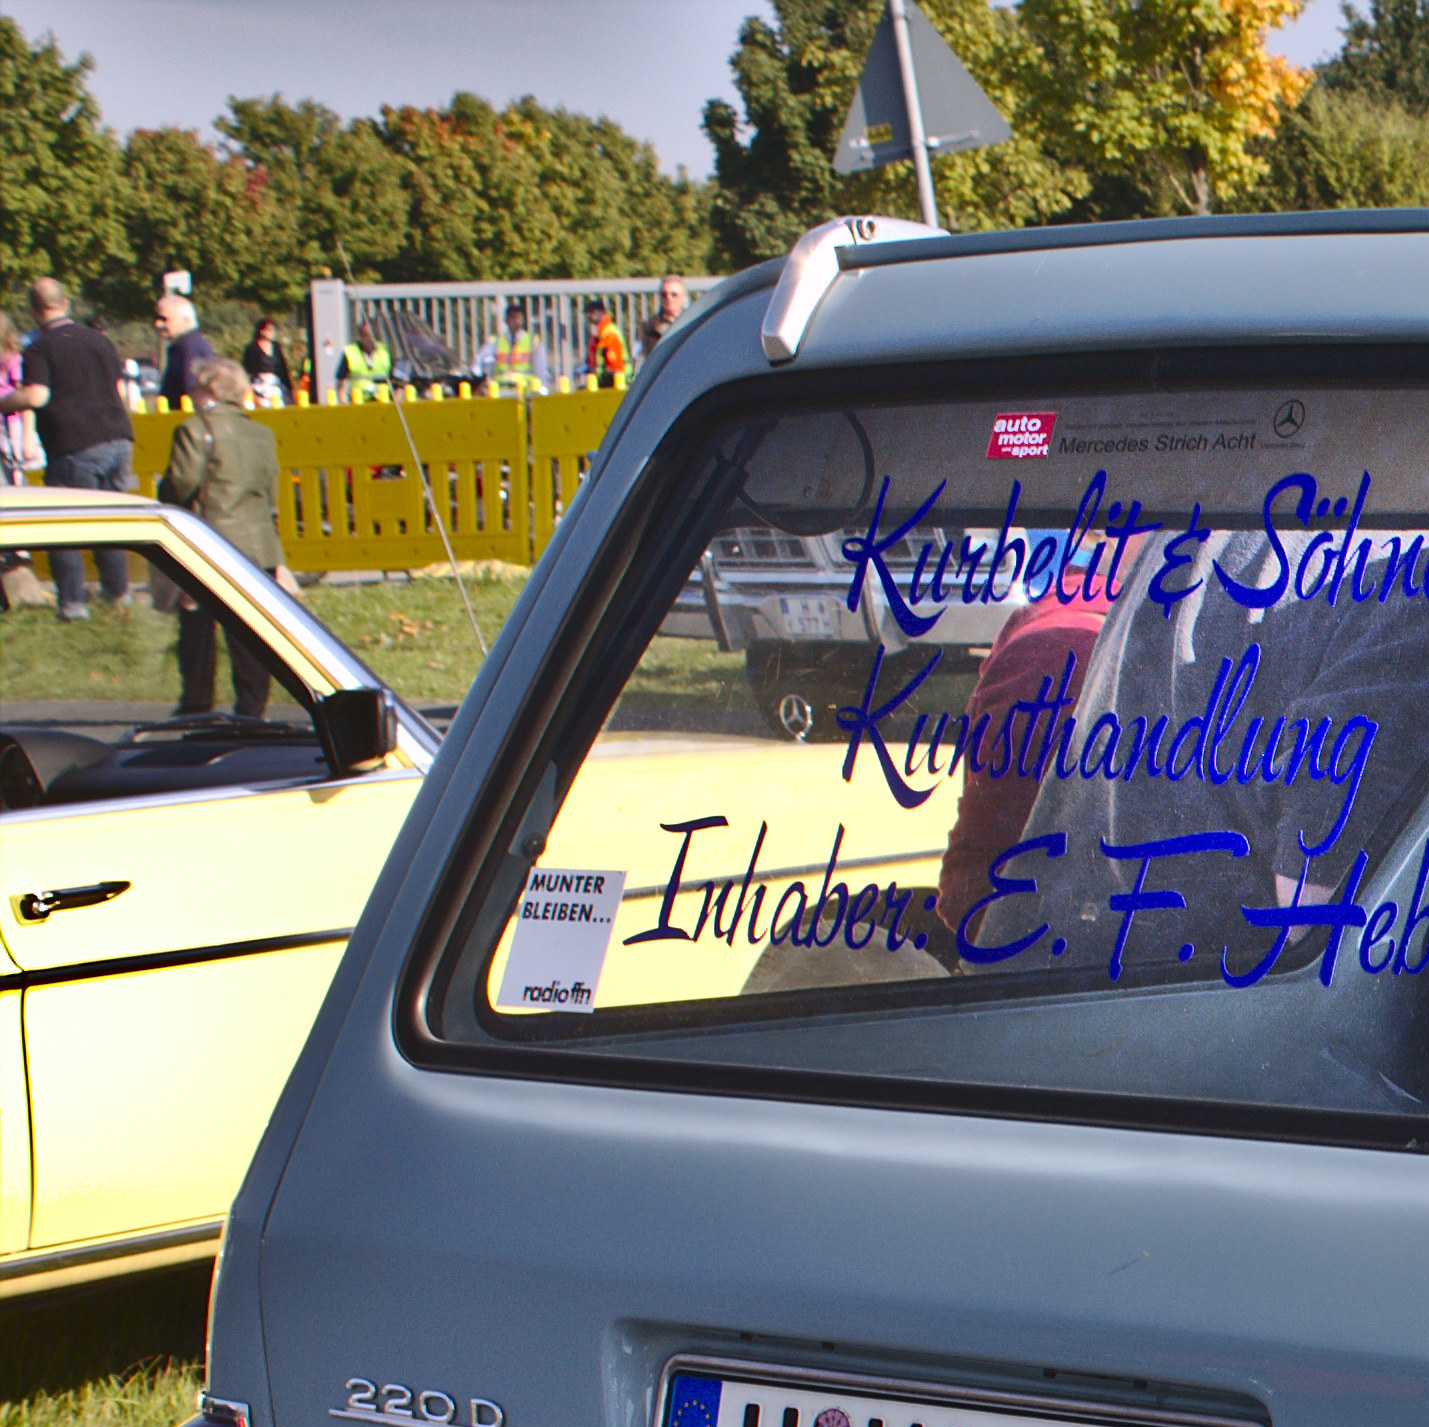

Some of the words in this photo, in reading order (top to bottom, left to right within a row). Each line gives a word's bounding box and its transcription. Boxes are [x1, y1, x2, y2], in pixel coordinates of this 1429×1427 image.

[993, 415, 1042, 433] auto
[997, 431, 1048, 446] motor
[1059, 436, 1149, 454] Mercedes
[1155, 434, 1208, 451] Strich
[1212, 432, 1257, 450] Acht
[843, 469, 1163, 638] Kurbelit
[835, 643, 1380, 857] Kunsthandlung
[529, 873, 606, 895] MUNTER
[521, 901, 612, 924] BLEIBEN...
[345, 1377, 456, 1423] 220
